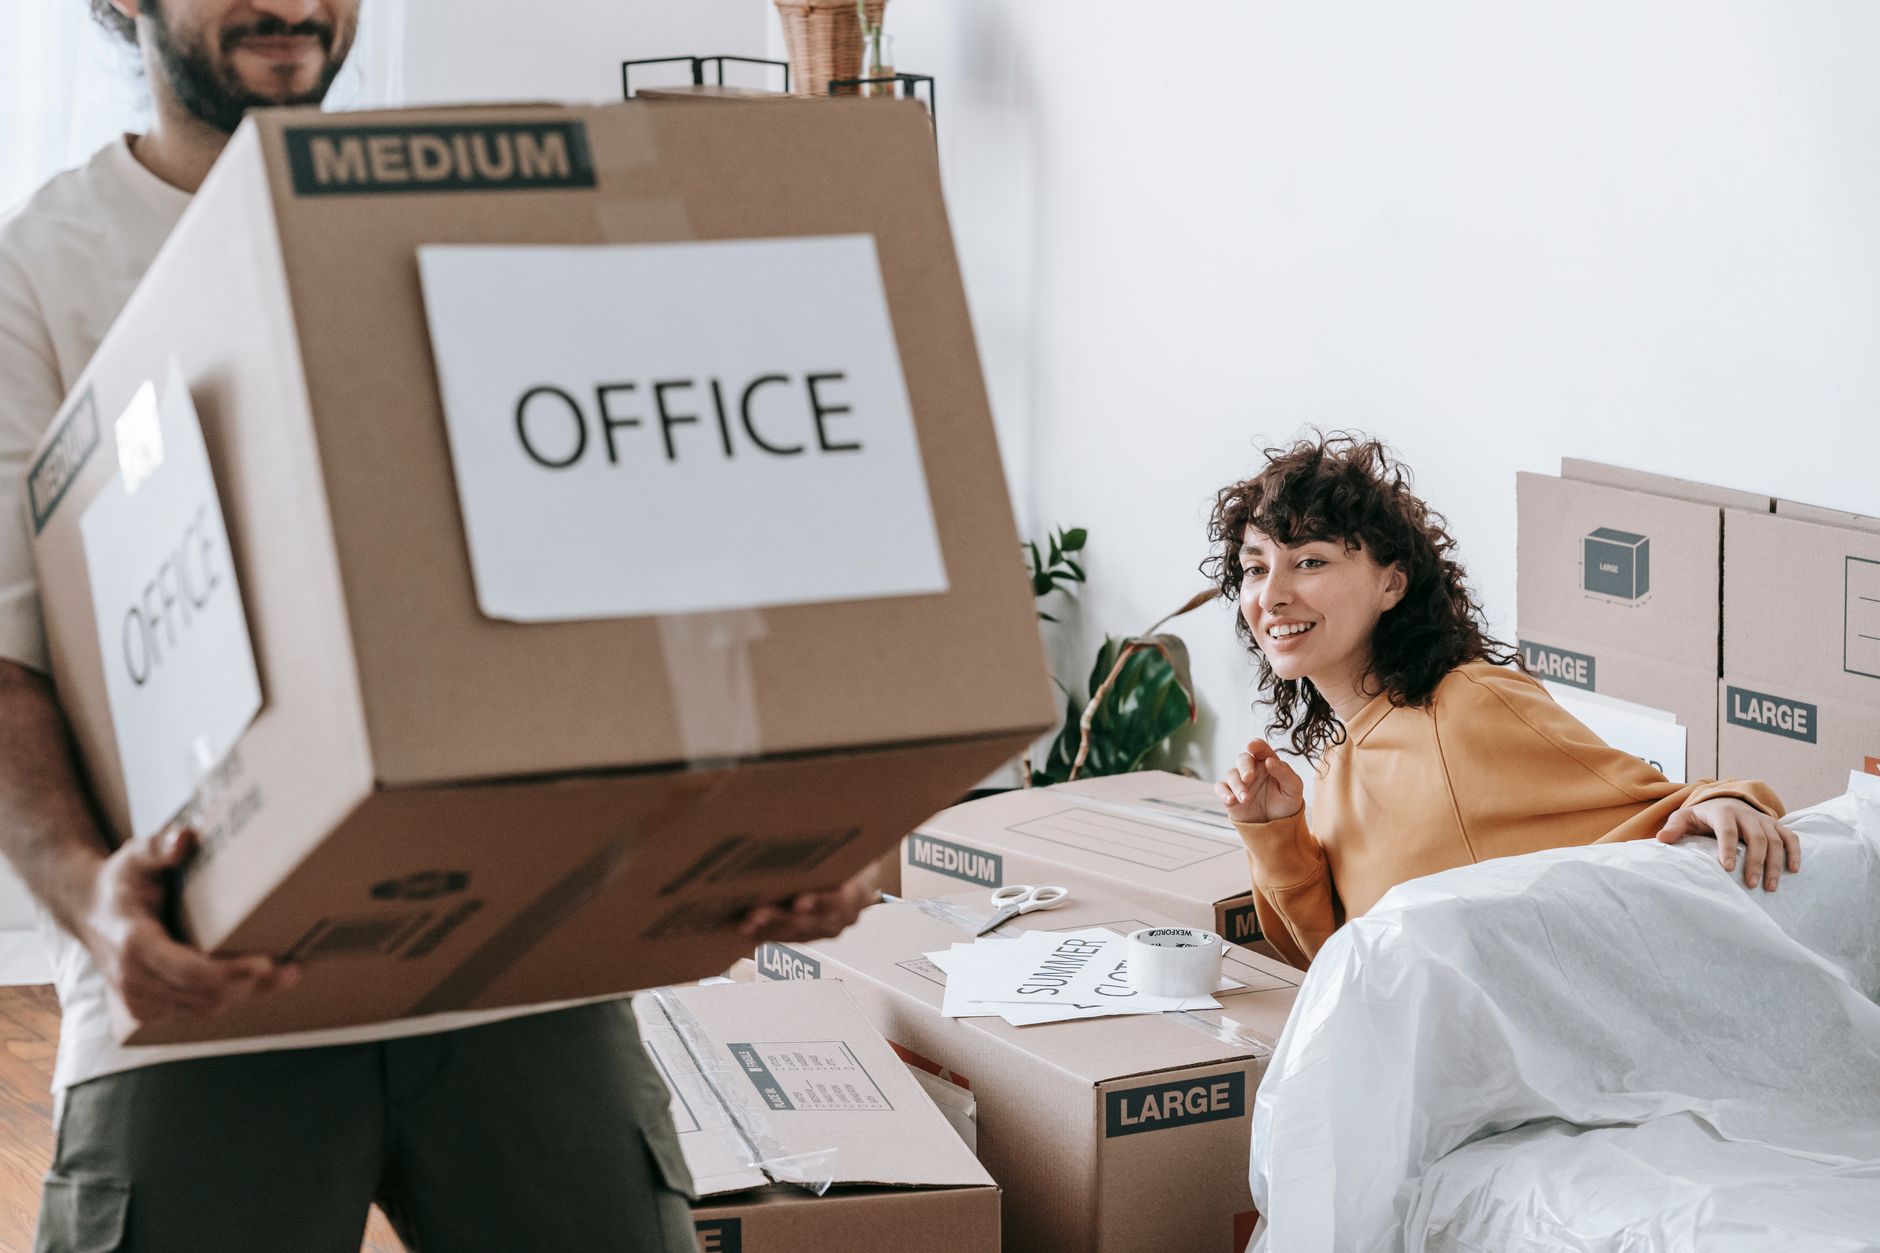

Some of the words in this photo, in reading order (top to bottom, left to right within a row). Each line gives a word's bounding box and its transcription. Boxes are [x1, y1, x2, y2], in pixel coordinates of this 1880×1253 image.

[309, 131, 572, 186] MEDIUM
[514, 371, 864, 469] OFFICE
[122, 505, 222, 688] OFFICE
[1525, 647, 1588, 685] LARGE
[1734, 693, 1808, 735] LARGE
[913, 844, 997, 884] MEDIUM
[1156, 928, 1193, 938] WEXFORD
[763, 943, 815, 981] LARGE
[1016, 938, 1108, 996] SUMMER
[1119, 1081, 1231, 1127] LARGE
